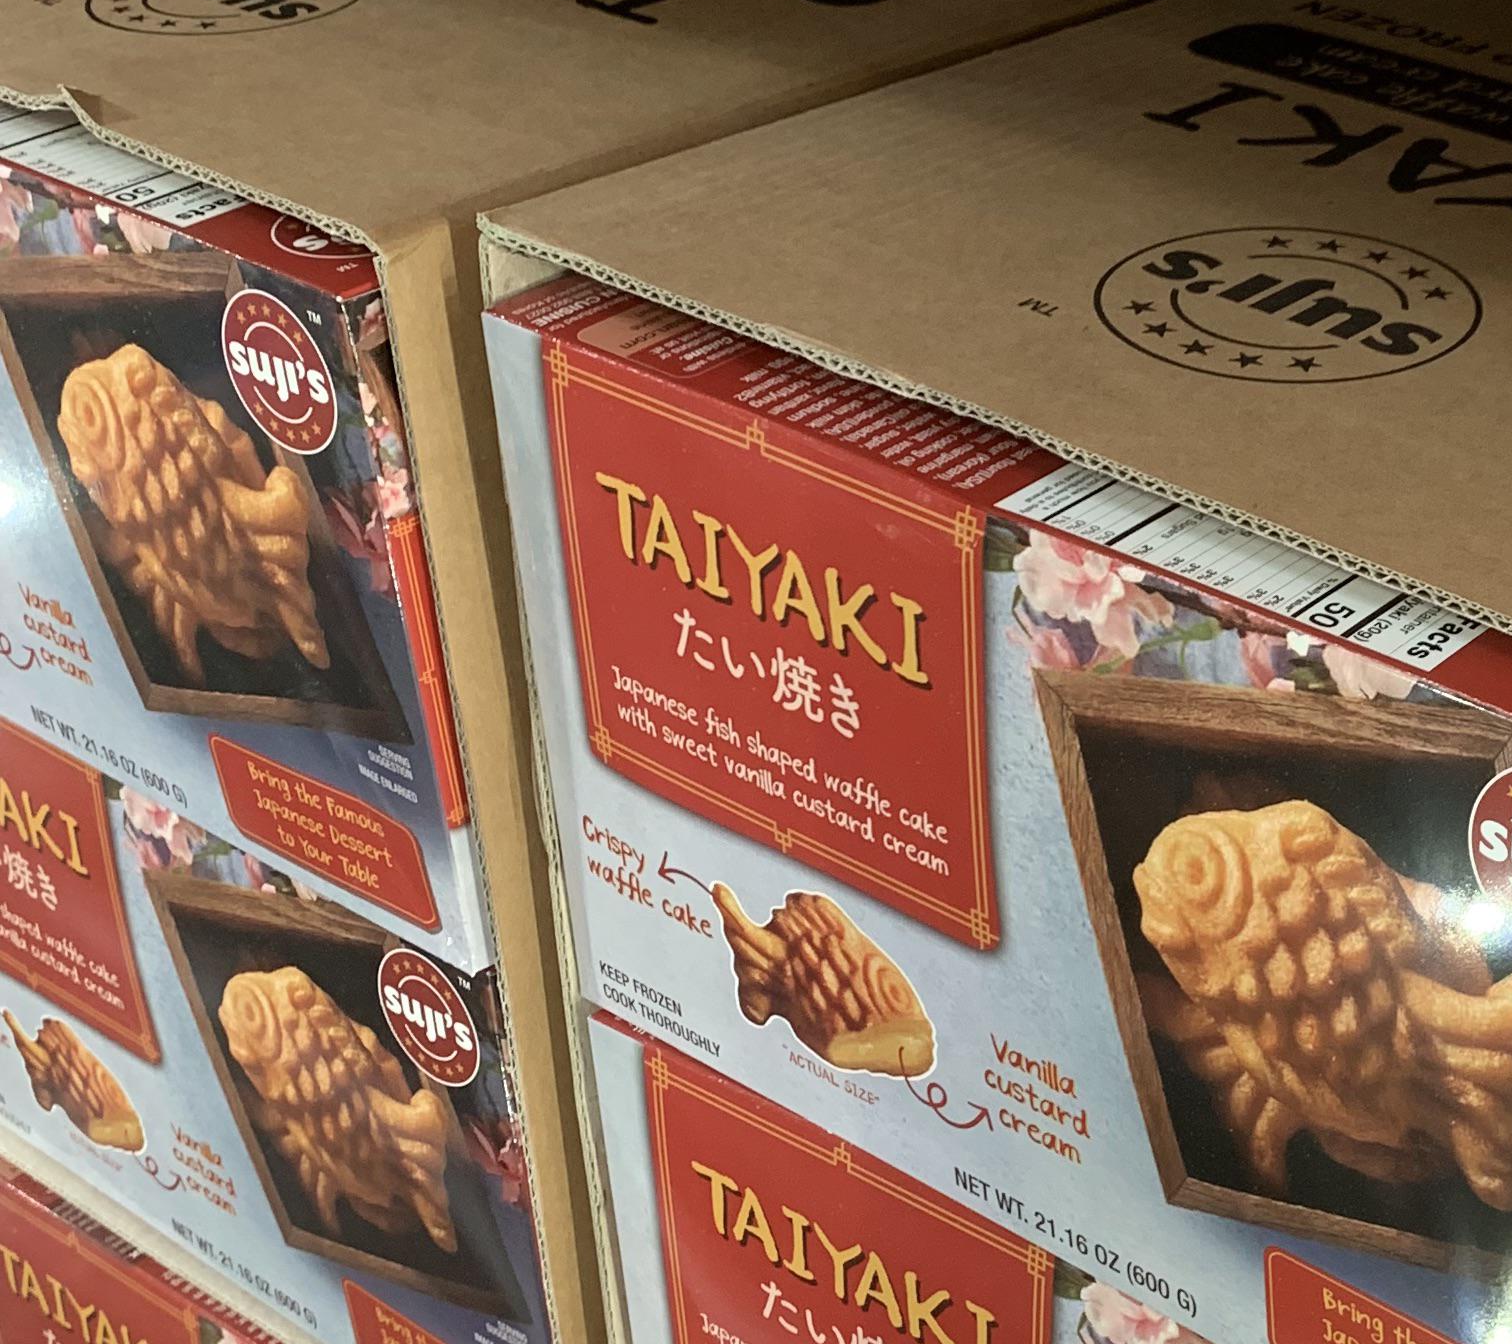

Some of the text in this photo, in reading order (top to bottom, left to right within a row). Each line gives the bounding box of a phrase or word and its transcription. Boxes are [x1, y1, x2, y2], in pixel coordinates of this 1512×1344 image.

[1141, 250, 1443, 356] suji's
[228, 340, 330, 405] suji's
[596, 471, 932, 687] TAIYAKI
[673, 607, 861, 739] たい焼き
[612, 665, 950, 844] Japanese fish shaped waffle cake
[617, 702, 950, 877] with sweet vanilla custard cream
[582, 816, 645, 871] Crispy
[587, 854, 714, 940] waffle cake
[385, 985, 473, 1053] suji's
[599, 960, 683, 1017] KEEP FROZEN
[602, 983, 721, 1058] COOK THOROUGHLY
[990, 1032, 1076, 1099] Vanilla
[984, 1068, 1090, 1140] custard
[999, 1105, 1082, 1165] cream
[954, 1167, 1200, 1319] NET WT. 21.16 OZ (600 G)
